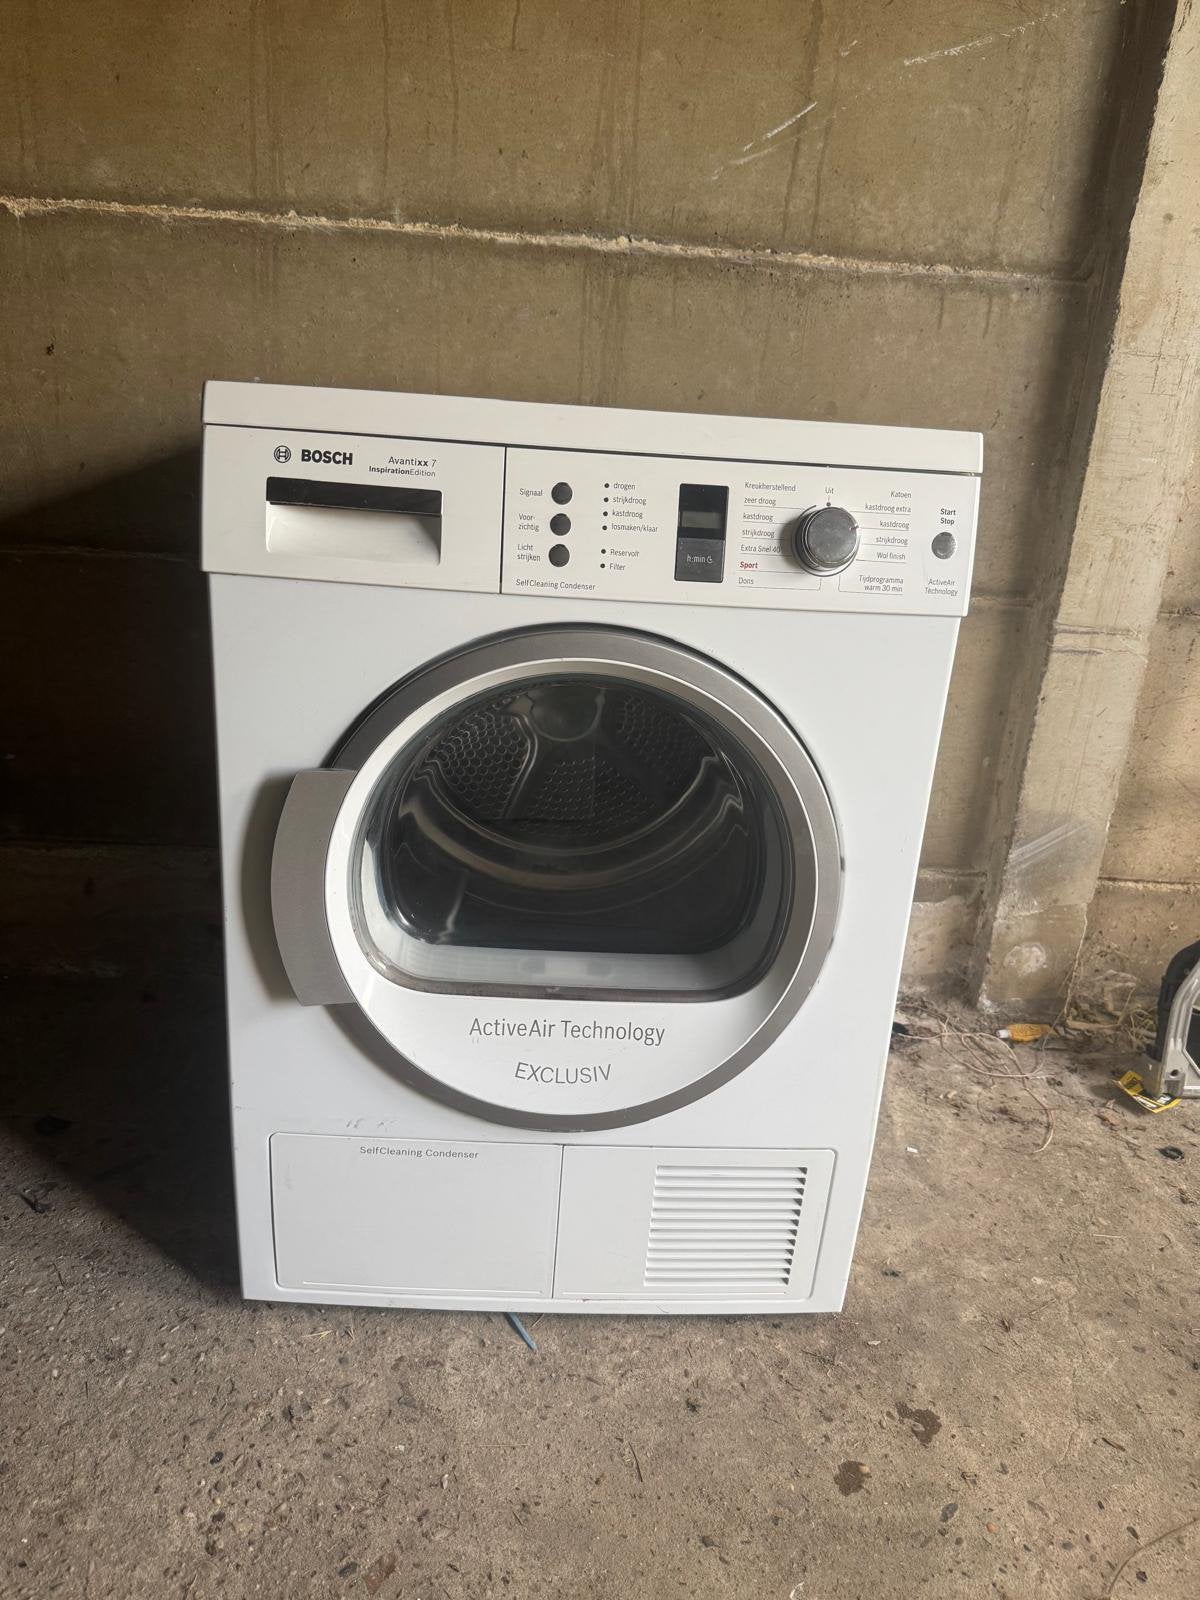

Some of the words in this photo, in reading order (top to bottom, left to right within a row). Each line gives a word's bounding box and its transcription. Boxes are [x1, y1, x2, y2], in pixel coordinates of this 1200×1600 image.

[301, 449, 353, 466] BOSCH
[388, 456, 428, 467] Avantixx
[431, 459, 437, 467] 7
[368, 466, 436, 477] InspirationEdition
[613, 482, 636, 491] drogen
[745, 482, 796, 492] Kreukherstellend
[519, 488, 543, 498] Signaal
[891, 491, 912, 499] Katoen
[612, 496, 647, 506] strijkdroog
[744, 497, 758, 505] zeer
[758, 497, 777, 506] droog
[865, 503, 895, 513] kastdroog
[940, 508, 956, 516] Start
[518, 513, 536, 521] Voor-
[612, 510, 643, 519] kastdroog
[742, 513, 773, 522] kastdroog
[879, 521, 910, 530] kastdroog
[940, 517, 955, 526] Stop
[518, 523, 540, 533] zichtig
[611, 523, 658, 533] losmaken/klaar
[741, 530, 775, 539] strijkdroog
[876, 536, 908, 546] strijkdroog
[517, 543, 533, 551] Licht
[740, 544, 757, 553] Extra
[757, 545, 772, 553] Snel
[610, 548, 640, 557] Reservoir
[889, 552, 906, 561] finish
[516, 553, 541, 562] strijken
[609, 563, 626, 571] Filter
[739, 561, 758, 570] Sport
[516, 579, 559, 590] SelfCleaning
[559, 581, 596, 591] Condenser
[738, 576, 754, 585] Dons
[859, 575, 904, 586] Tijdprogramma
[928, 578, 956, 587] ActiveAir
[864, 584, 881, 592] warm
[892, 585, 903, 593] min
[925, 587, 958, 597] Technology
[469, 1017, 556, 1038] ActiveAir
[561, 1020, 666, 1047] Technology
[514, 1061, 612, 1084] EXCLUSIV
[359, 1146, 423, 1158] SelfCleaning
[425, 1149, 479, 1159] Condenser
